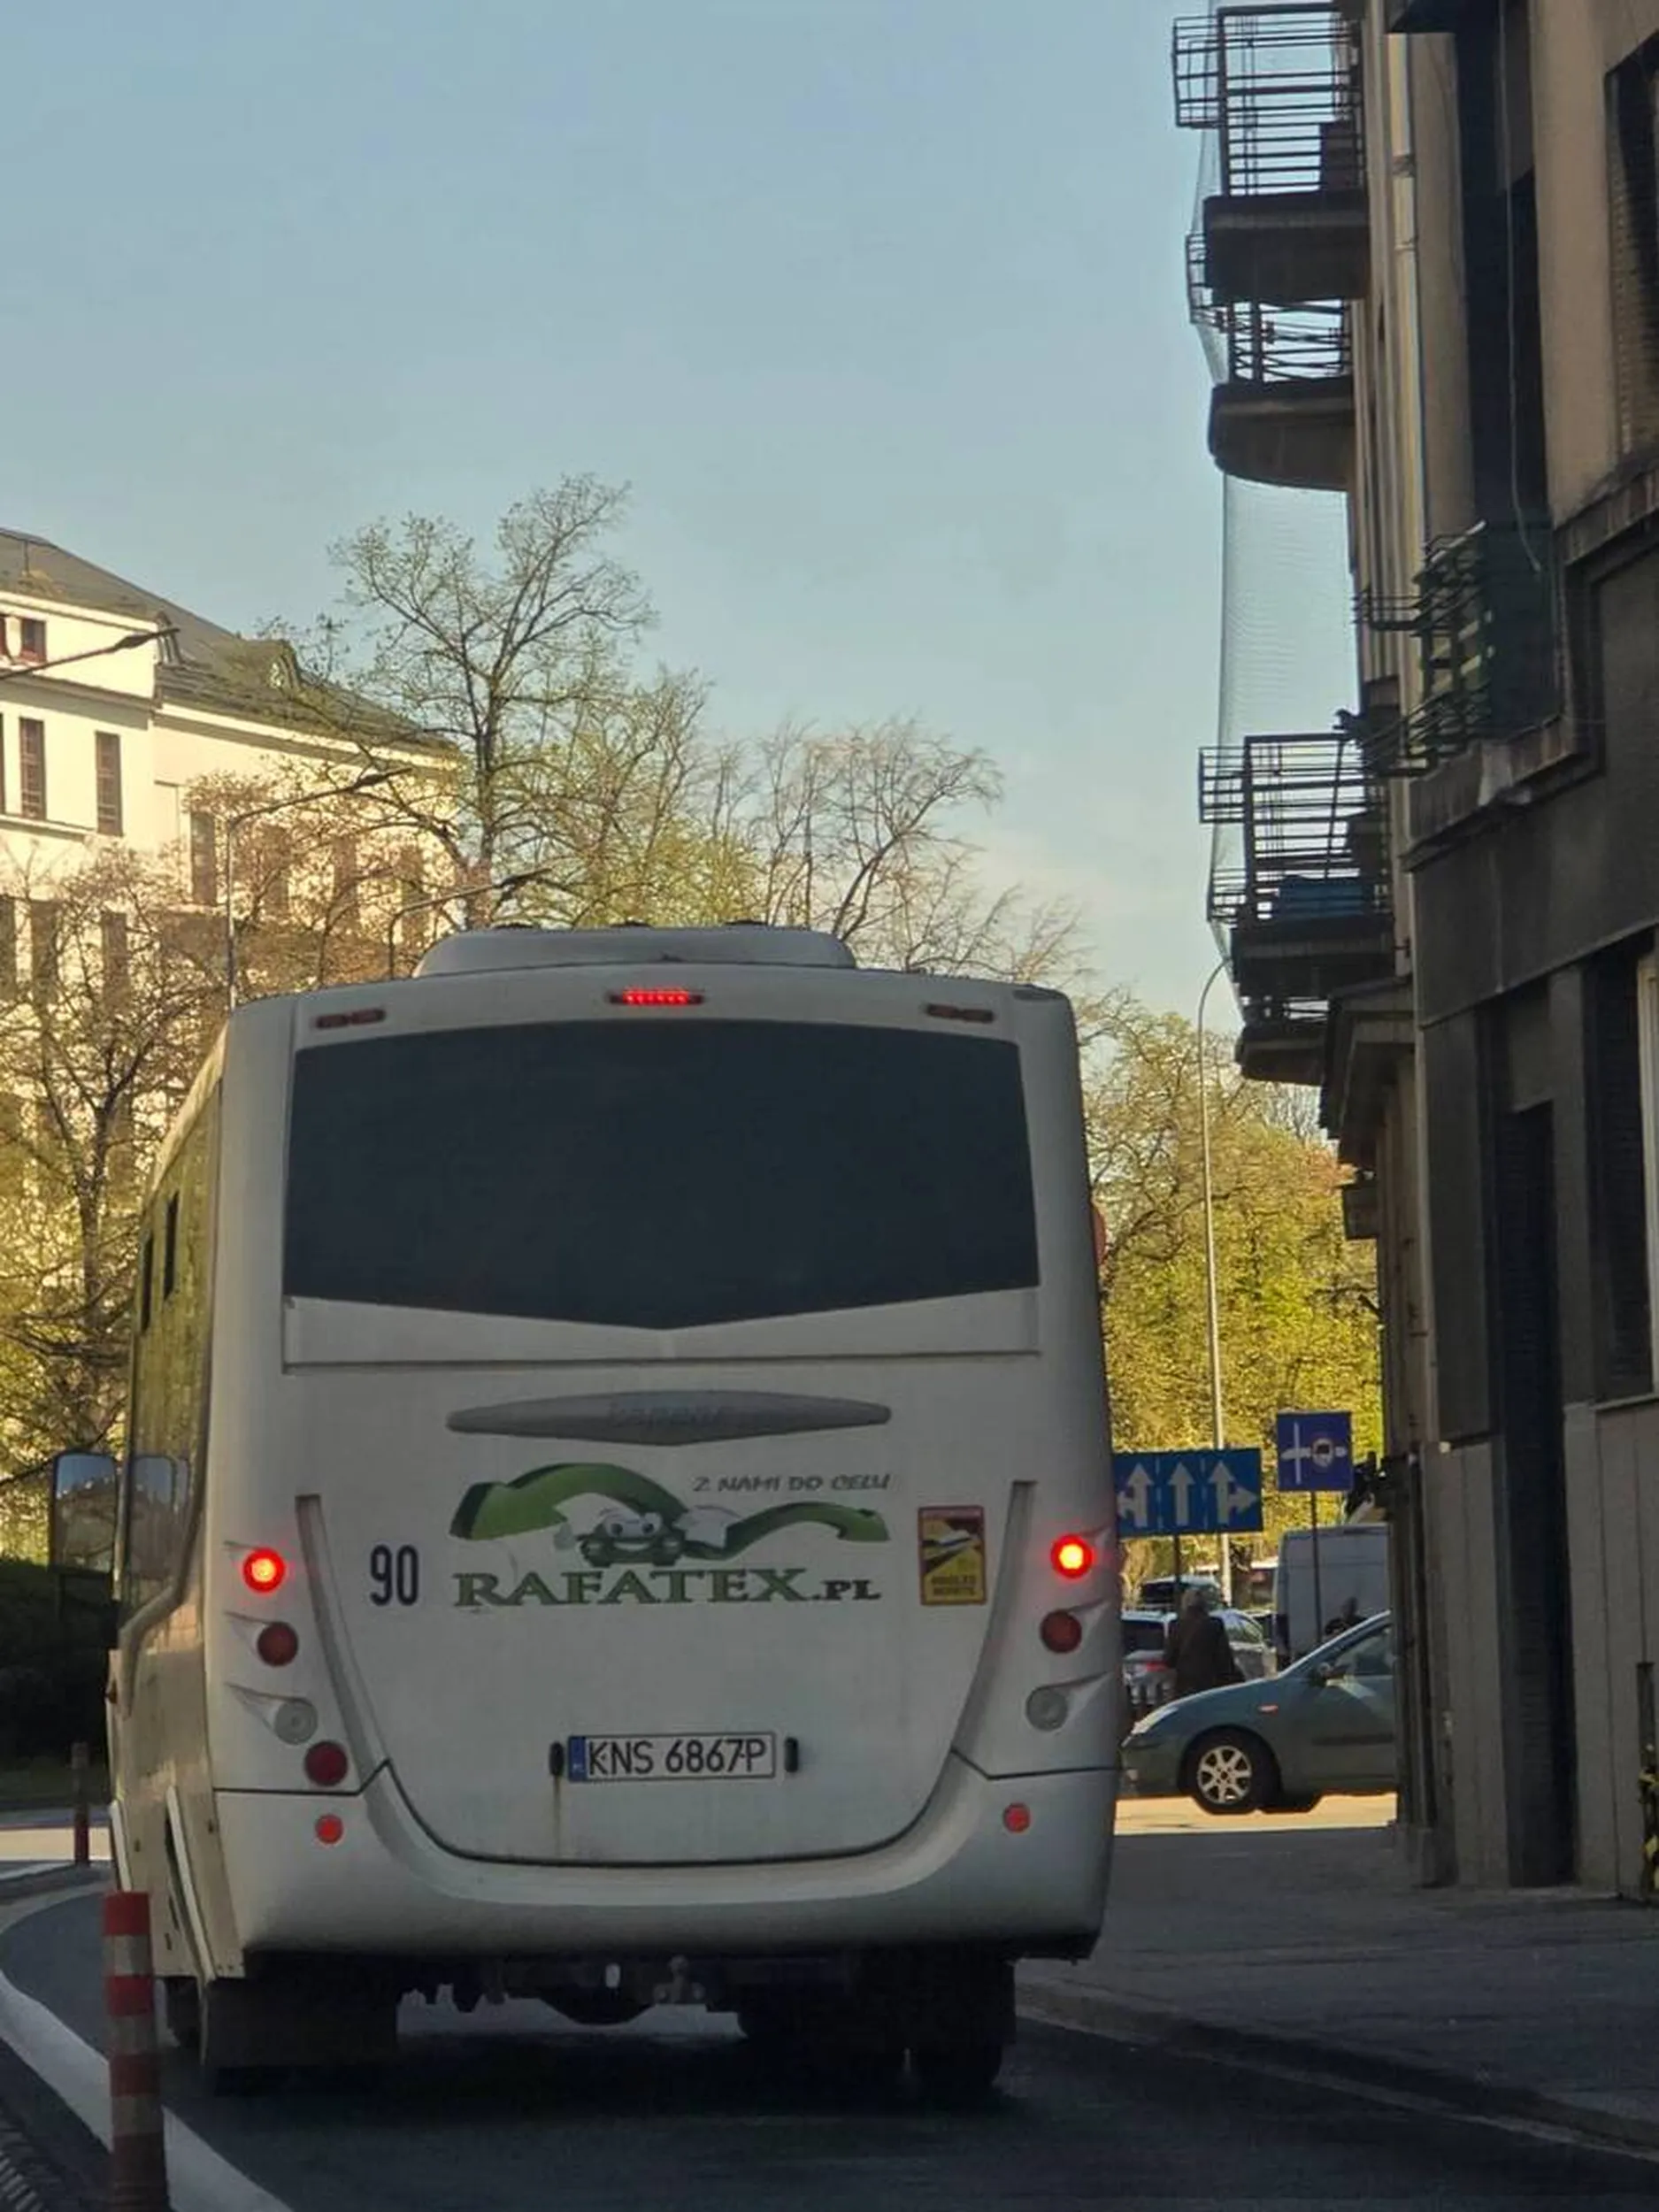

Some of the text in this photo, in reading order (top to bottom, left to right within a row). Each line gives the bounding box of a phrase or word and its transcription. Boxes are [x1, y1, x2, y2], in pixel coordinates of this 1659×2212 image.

[718, 1475, 781, 1493] NAMI
[788, 1475, 824, 1492] DO
[831, 1473, 892, 1491] CELU
[370, 1544, 419, 1607] 90
[451, 1568, 882, 1607] RAFATEX.PL
[588, 1738, 767, 1776] KNS 6867P
